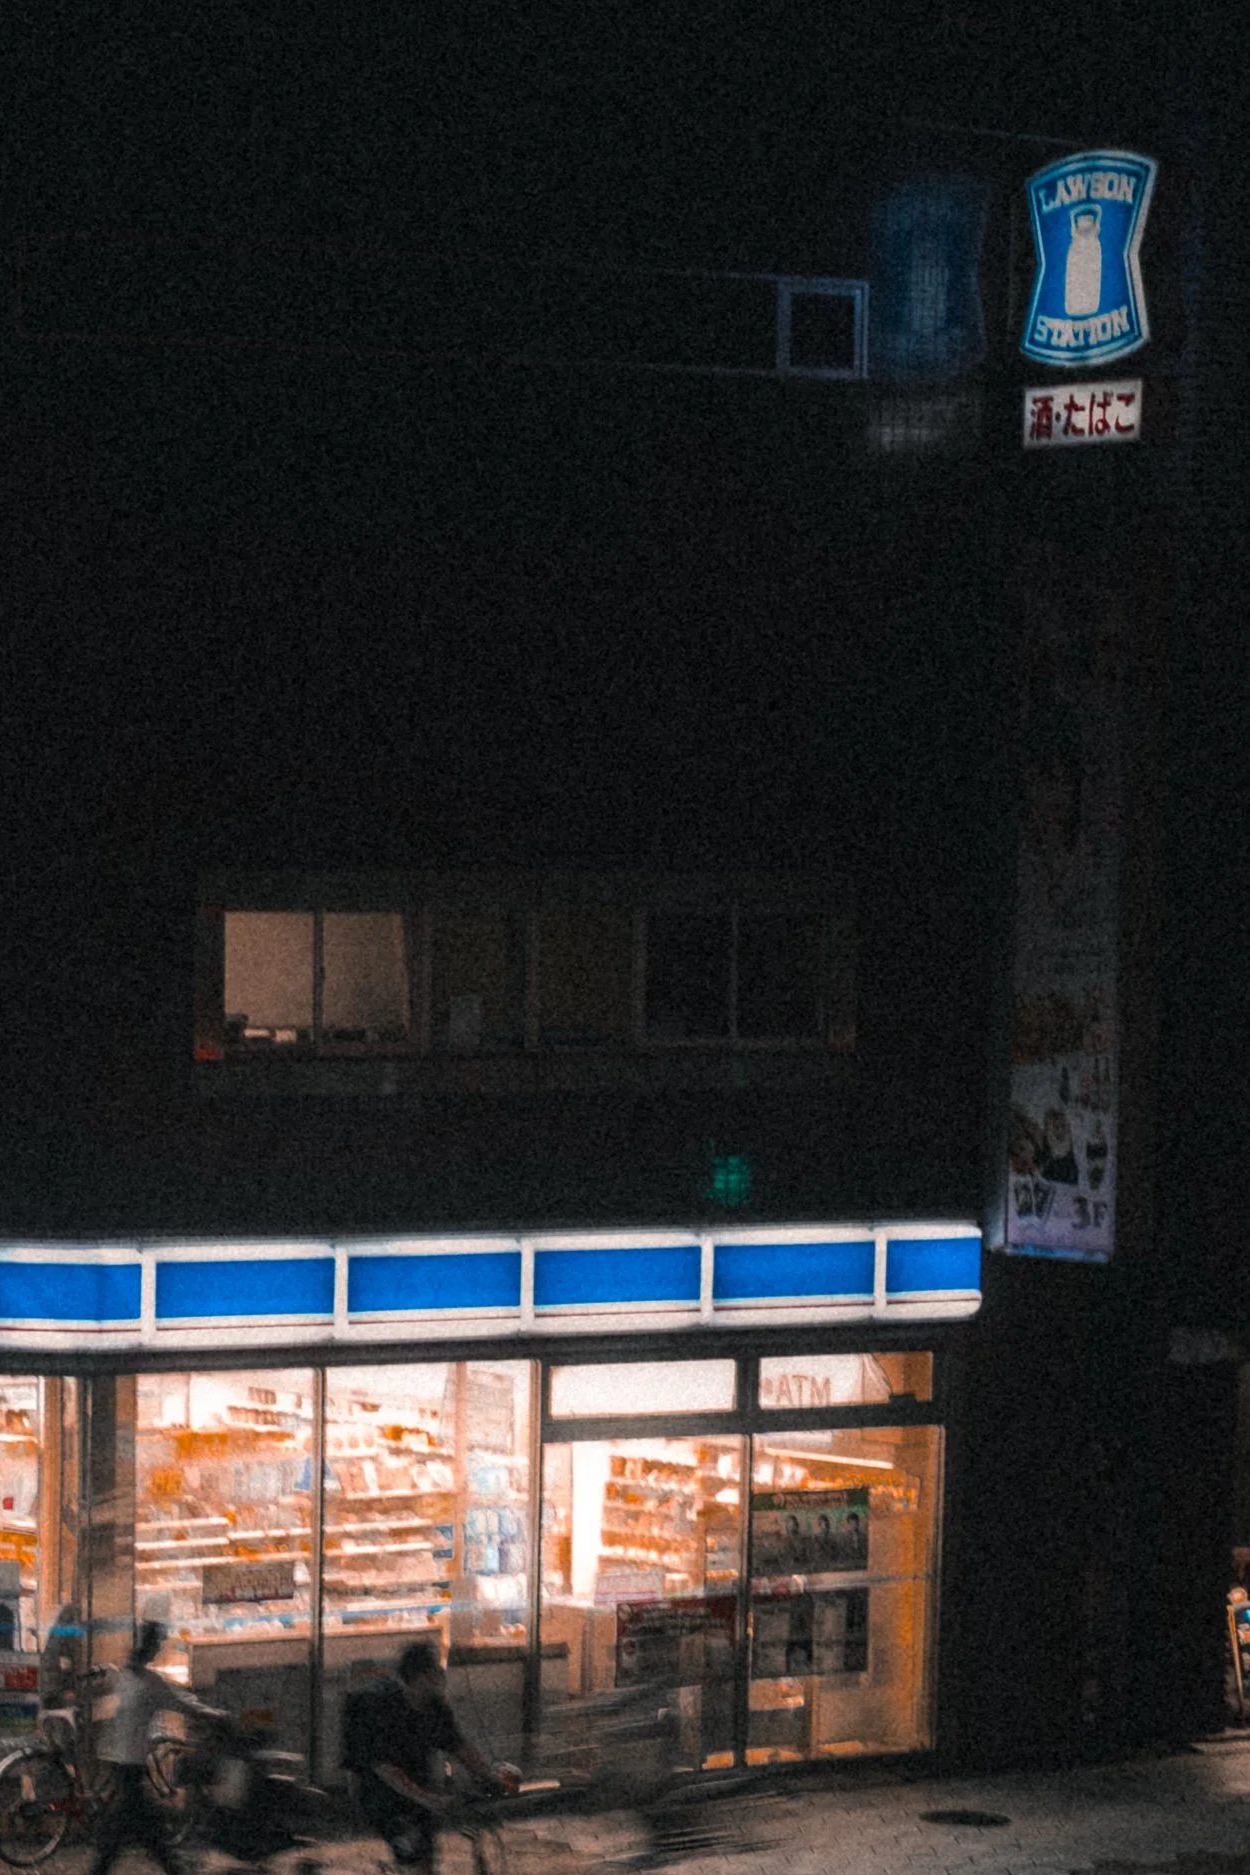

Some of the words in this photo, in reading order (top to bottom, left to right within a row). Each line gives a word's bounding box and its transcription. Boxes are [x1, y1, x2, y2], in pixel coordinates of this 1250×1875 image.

[1038, 172, 1136, 213] LAWSON
[1034, 304, 1130, 347] STATION
[1030, 390, 1136, 440] 酒・たばこ
[776, 1373, 831, 1407] ATM
